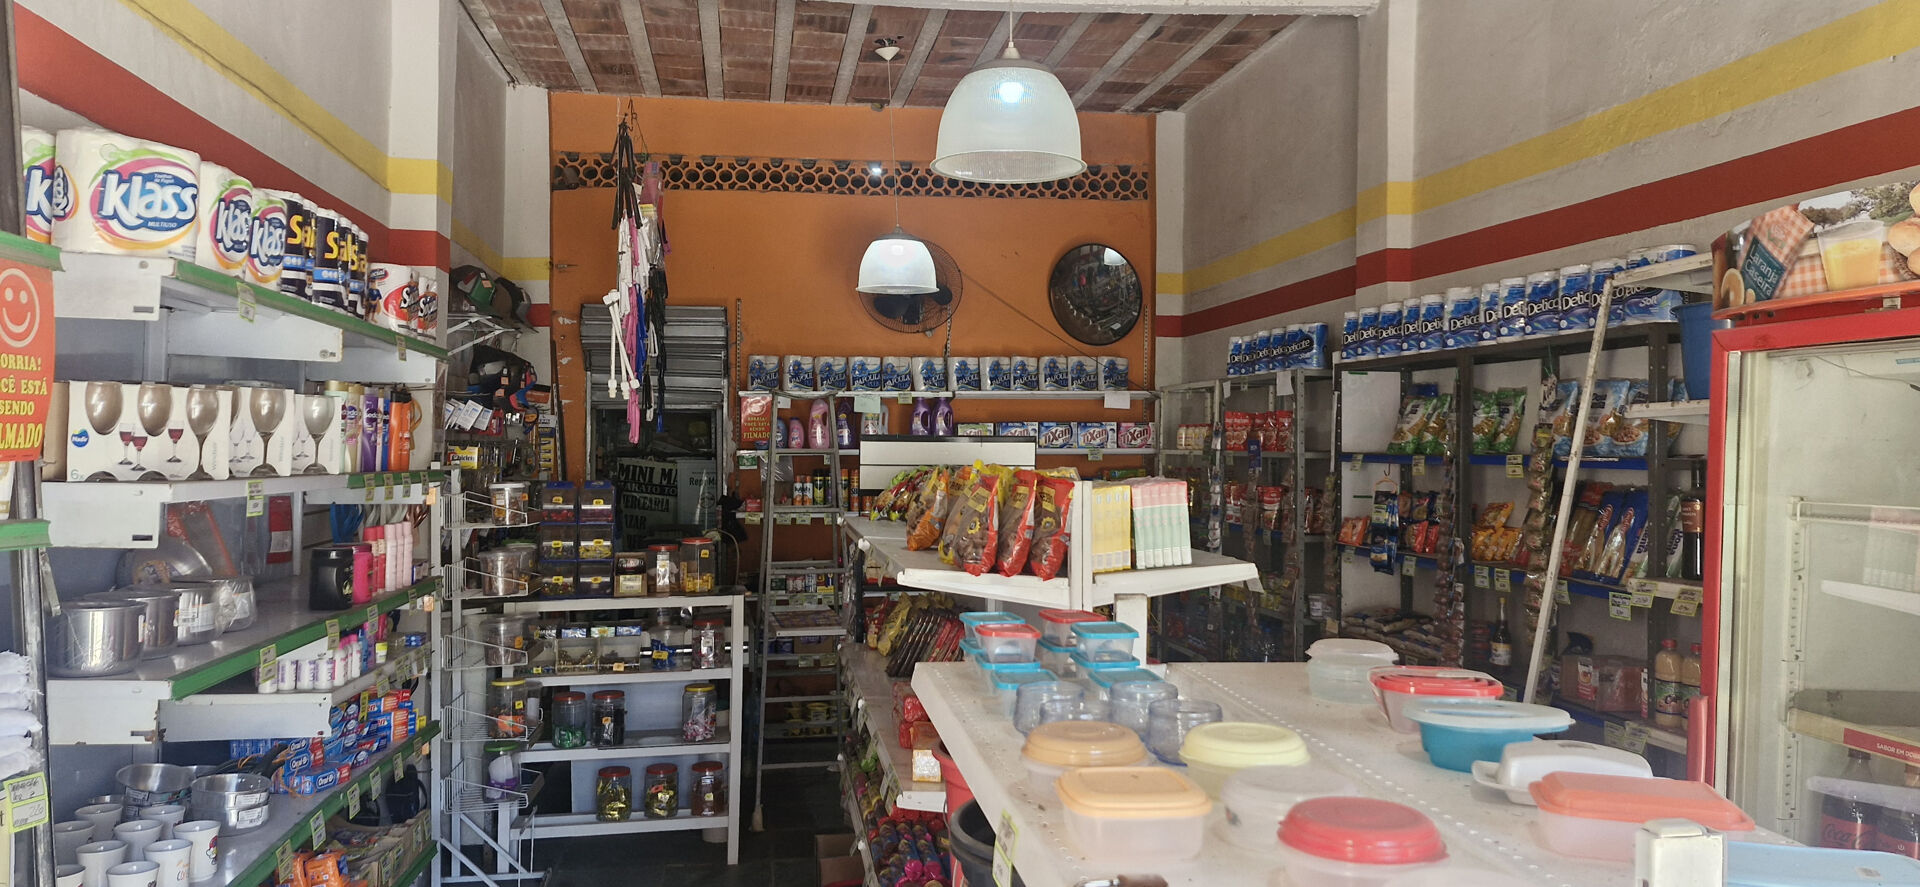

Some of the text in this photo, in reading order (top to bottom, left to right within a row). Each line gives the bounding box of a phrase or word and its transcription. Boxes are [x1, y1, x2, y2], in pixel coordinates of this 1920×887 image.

[102, 173, 197, 226] Klass
[1749, 244, 1779, 284] Laranja
[1745, 258, 1773, 297] Caseira
[0, 353, 41, 371] ORRIA!
[0, 375, 48, 395] CÊ ESTÁ
[0, 422, 43, 449] LMADO
[618, 463, 655, 484] MINI
[619, 480, 660, 493] ARATO
[1876, 742, 1896, 753] SABOR
[317, 773, 334, 786] Oral-B
